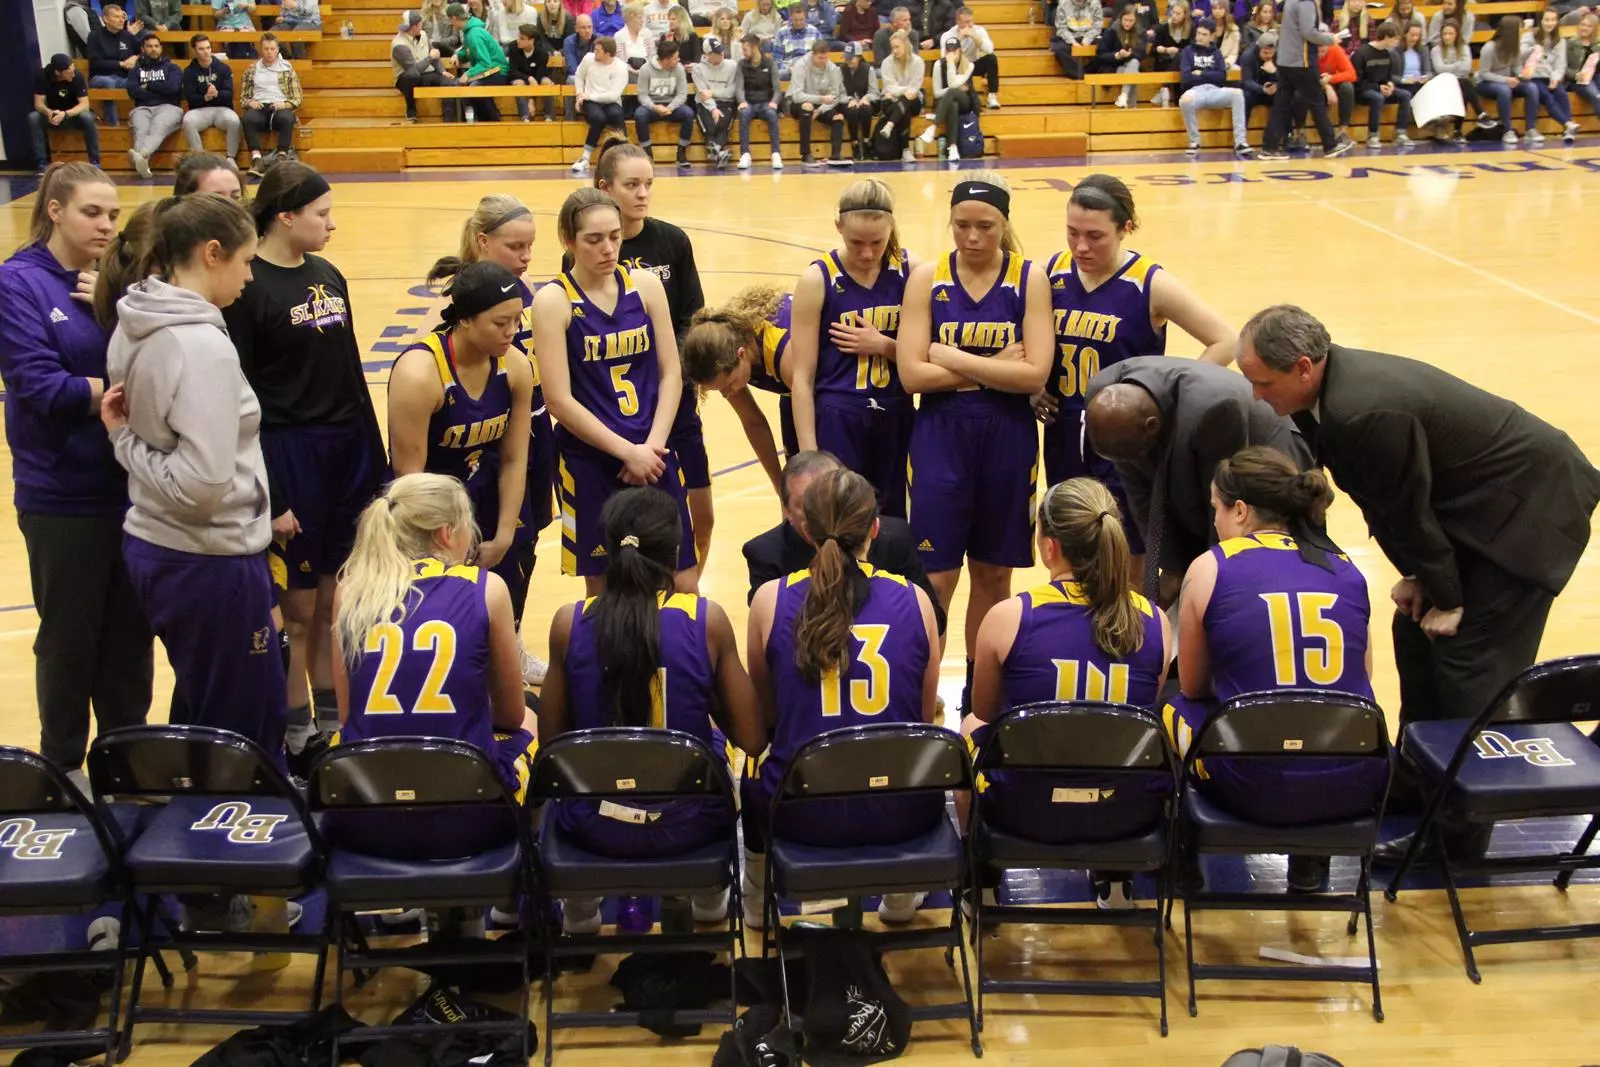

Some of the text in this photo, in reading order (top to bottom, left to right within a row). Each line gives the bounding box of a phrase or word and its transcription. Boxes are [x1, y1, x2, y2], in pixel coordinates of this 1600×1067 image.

[290, 302, 313, 325] ST.
[1066, 310, 1122, 343] KATE'S
[610, 363, 639, 417] 5
[1058, 343, 1100, 397] 30
[1259, 592, 1346, 686] 15
[363, 620, 457, 714] 22
[820, 624, 890, 716] 13
[1472, 731, 1576, 767] BU
[0, 818, 76, 860] BU
[191, 801, 288, 844] BU
